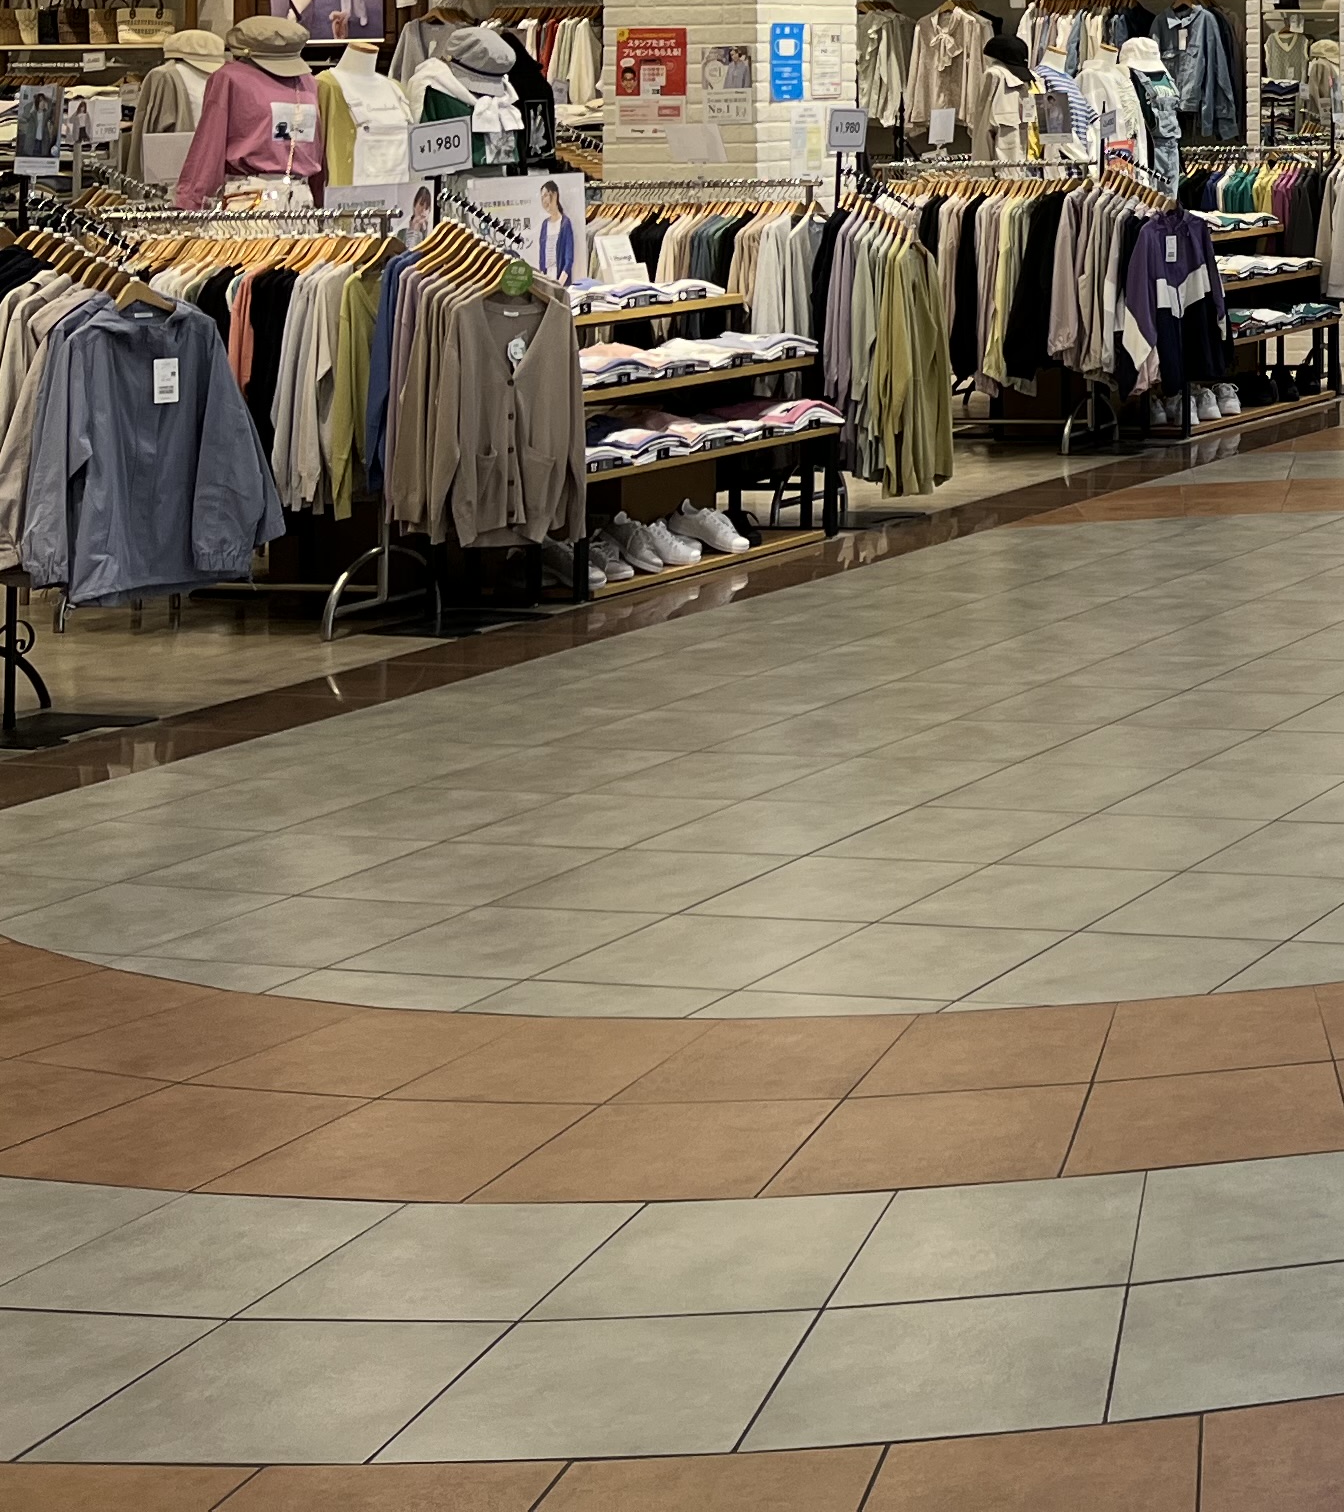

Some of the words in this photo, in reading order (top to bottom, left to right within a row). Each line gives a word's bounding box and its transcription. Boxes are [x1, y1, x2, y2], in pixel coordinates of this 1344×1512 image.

[627, 39, 676, 47] スタンプたまって
[708, 104, 730, 114] No.1
[835, 121, 861, 134] ¥1,980
[419, 134, 461, 154] ¥1,980
